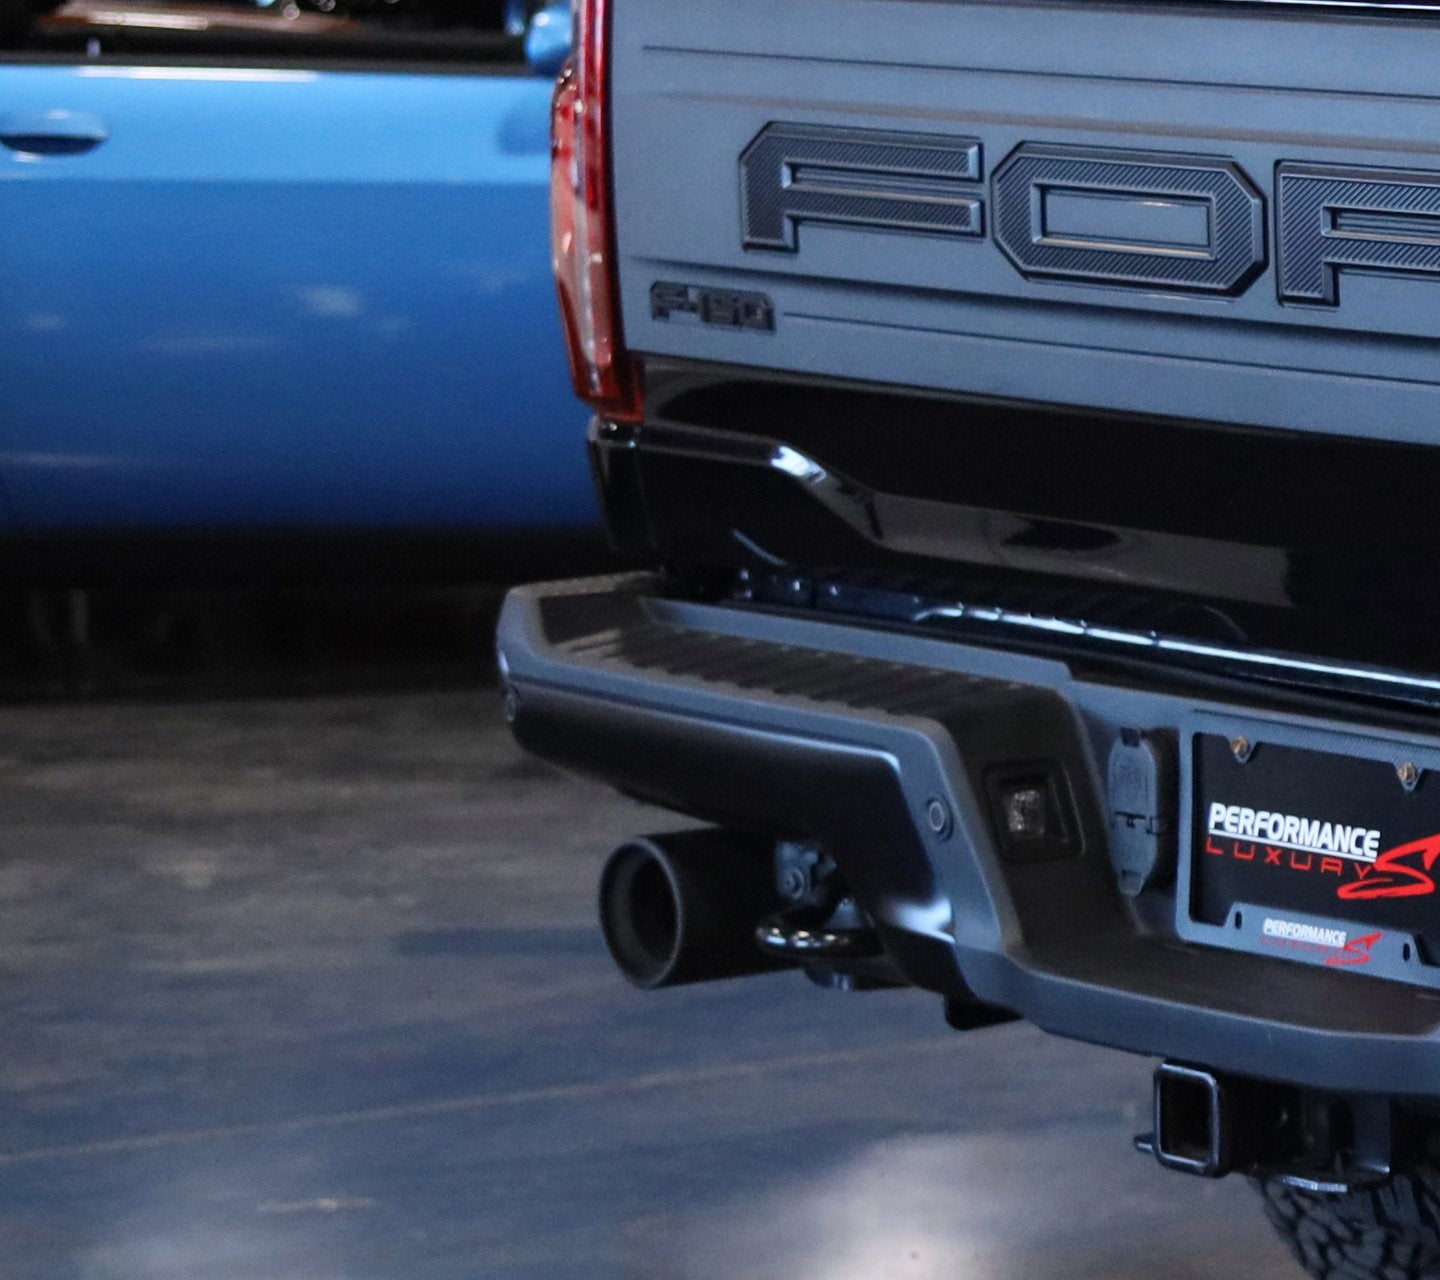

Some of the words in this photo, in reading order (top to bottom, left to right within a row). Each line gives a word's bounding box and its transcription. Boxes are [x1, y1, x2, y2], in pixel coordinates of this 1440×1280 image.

[1208, 801, 1381, 860] PERFORMANCE
[1206, 835, 1374, 879] LUXURY
[1262, 917, 1348, 948] PERFORMANCE
